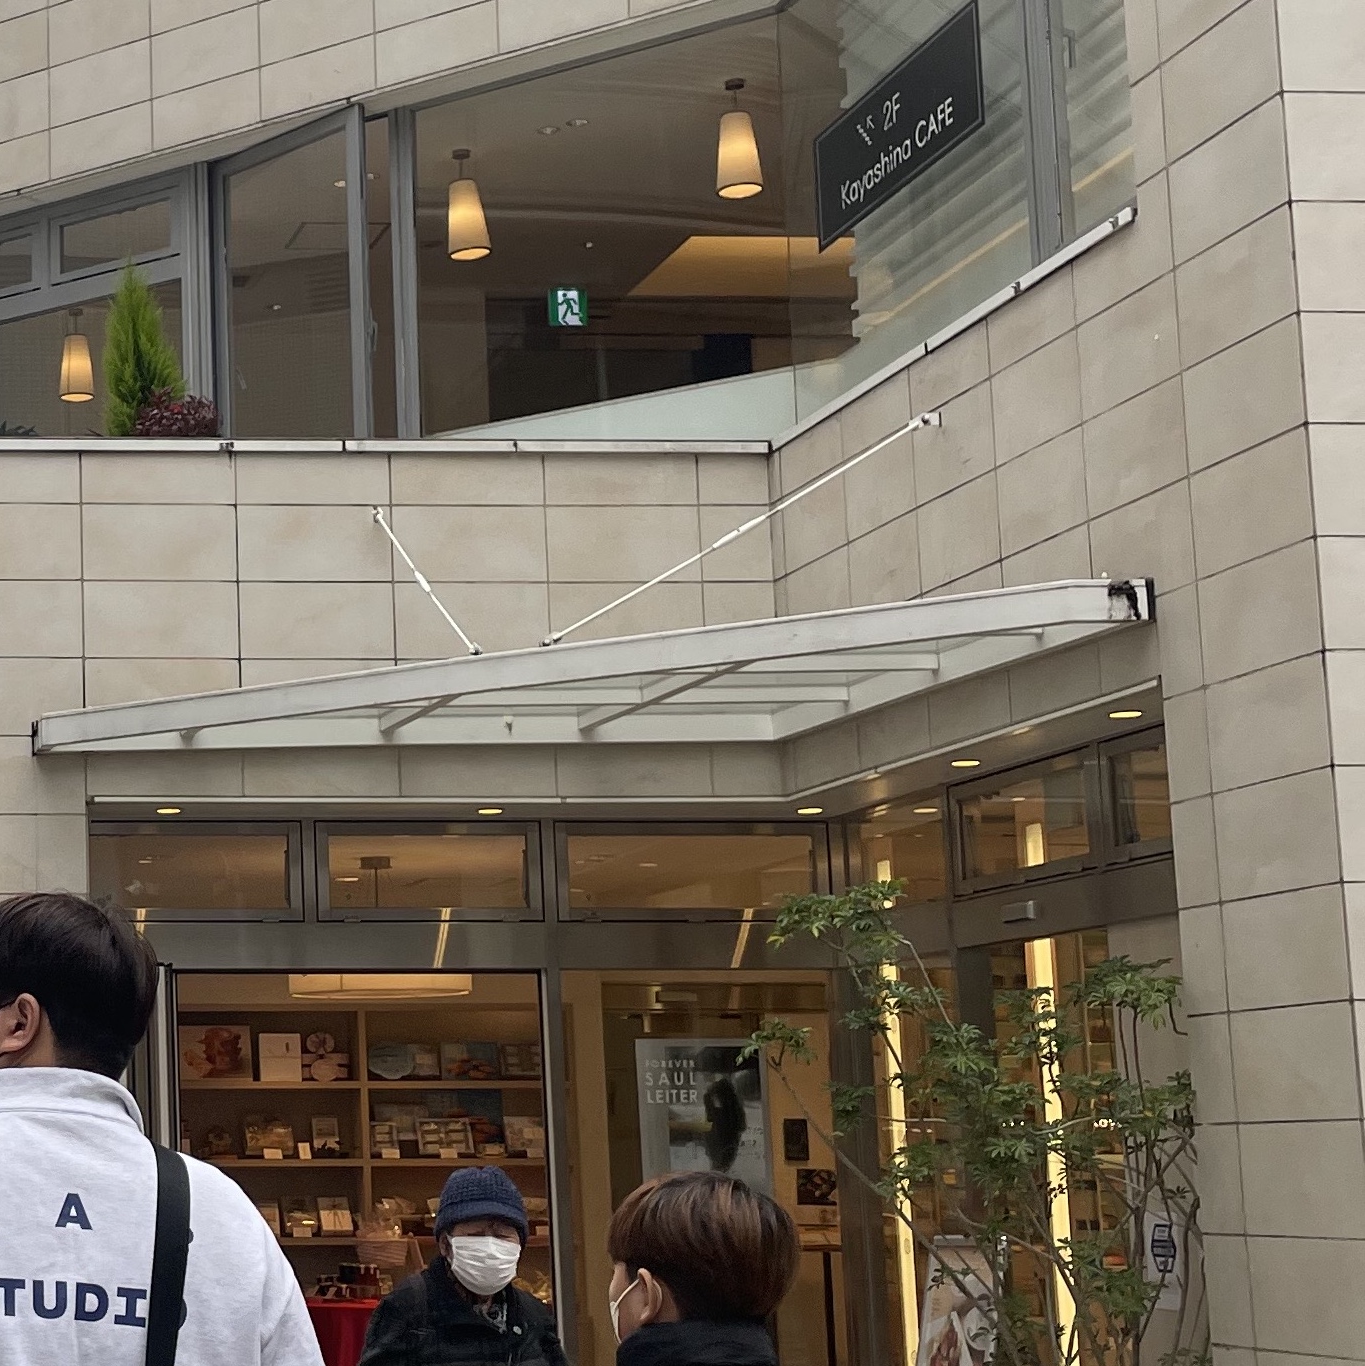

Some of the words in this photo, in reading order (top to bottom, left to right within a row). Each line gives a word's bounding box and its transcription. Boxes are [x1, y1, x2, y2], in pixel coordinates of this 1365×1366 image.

[883, 92, 901, 131] 2F
[840, 138, 912, 210] Kayashina
[915, 97, 954, 148] CAFE
[645, 1071, 696, 1086] SAUL
[647, 1089, 698, 1104] LEITER
